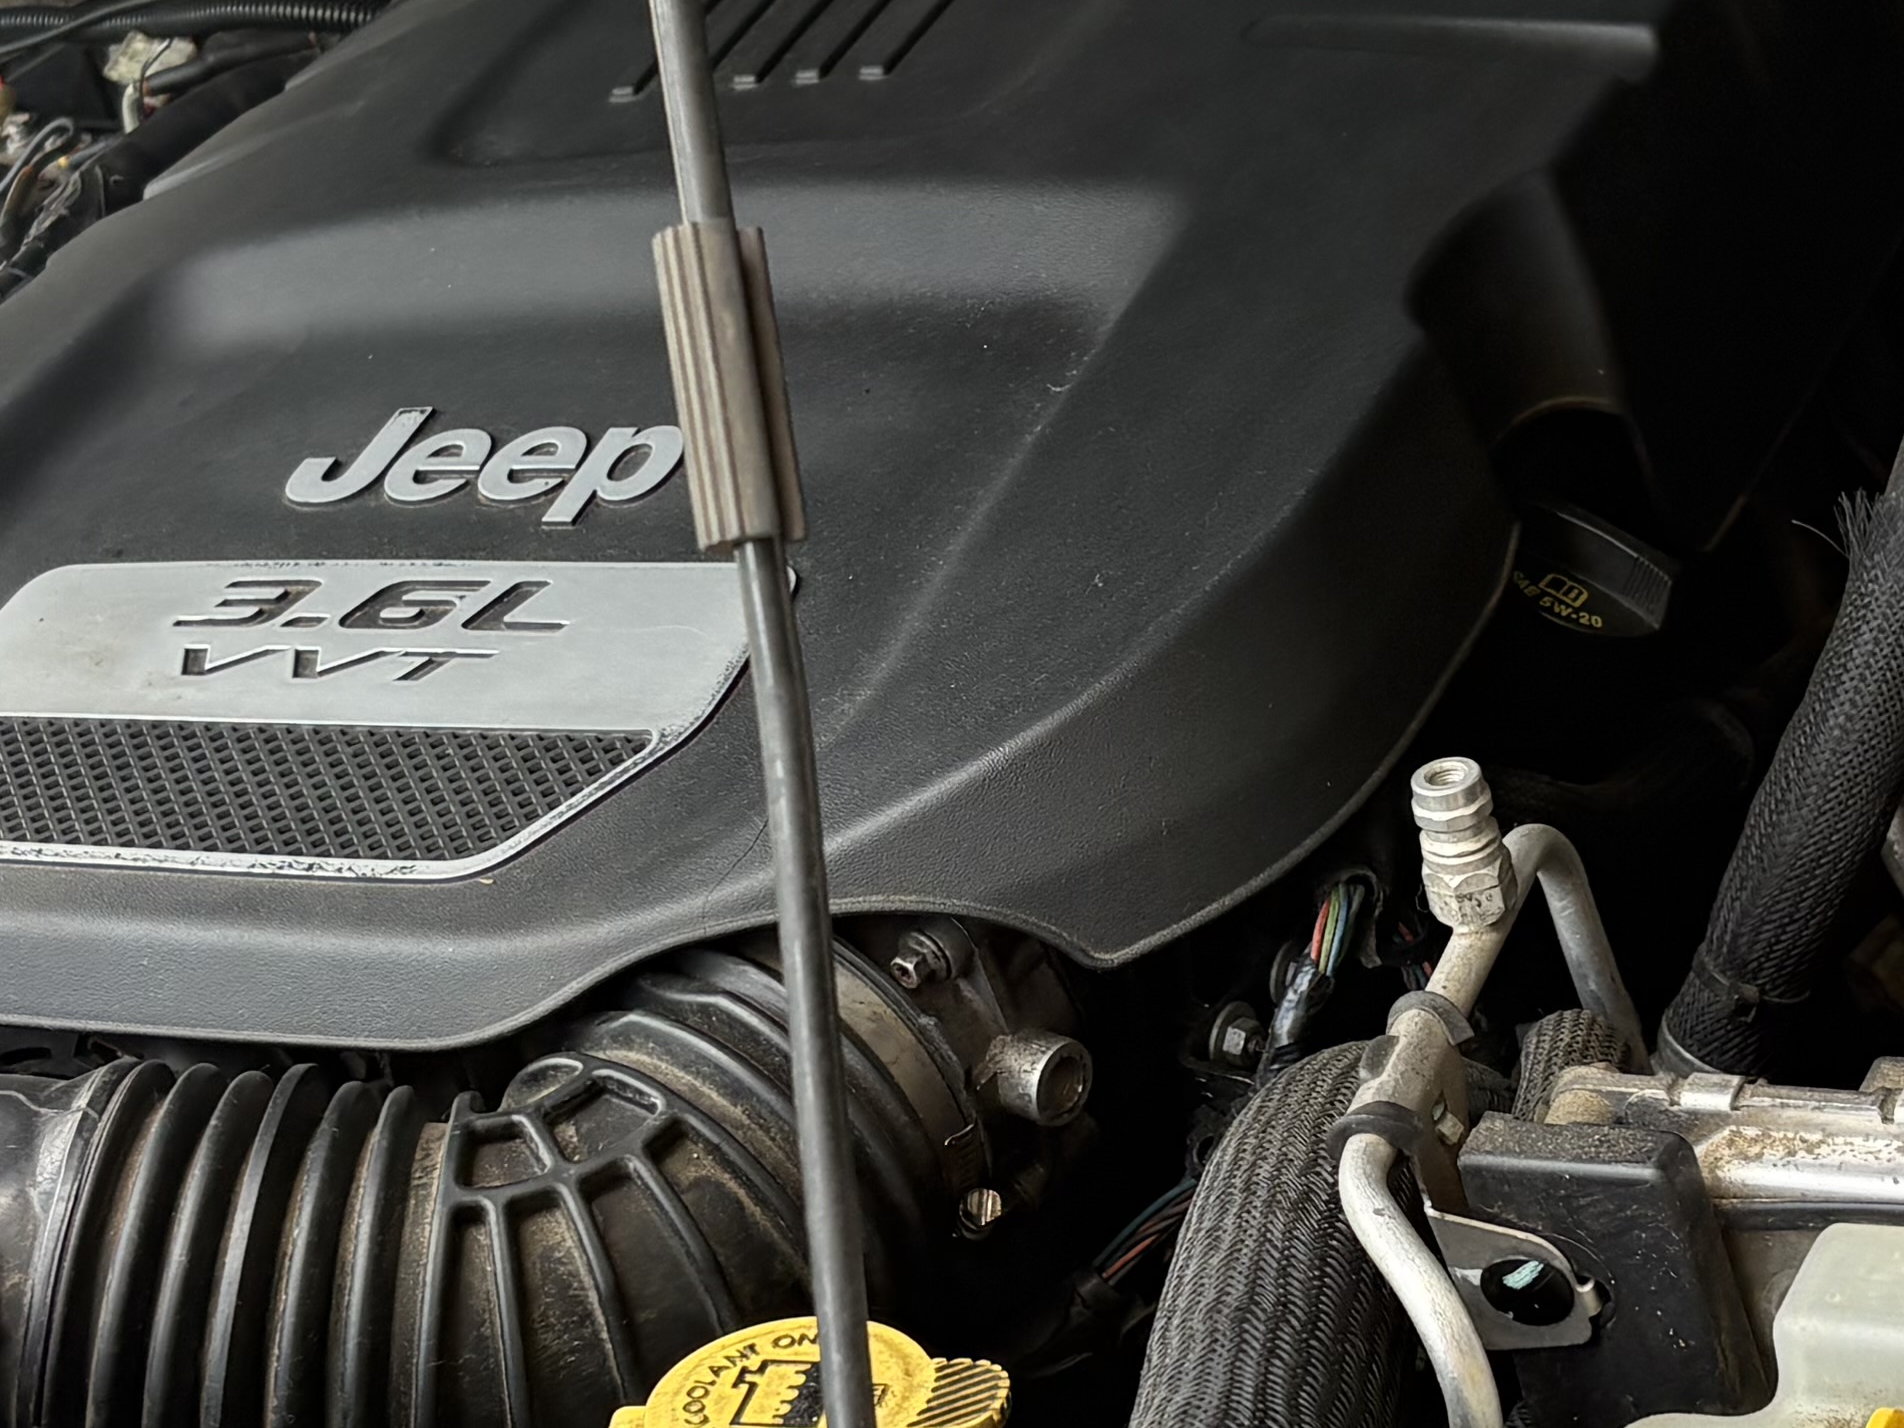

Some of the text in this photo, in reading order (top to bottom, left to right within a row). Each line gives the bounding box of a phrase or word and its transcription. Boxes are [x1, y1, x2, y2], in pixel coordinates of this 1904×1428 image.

[284, 406, 686, 529] Jeep
[172, 576, 571, 634] 3.6L
[1539, 595, 1603, 629] 5W-20
[180, 643, 501, 682] VVT
[682, 1341, 760, 1428] COOLANT
